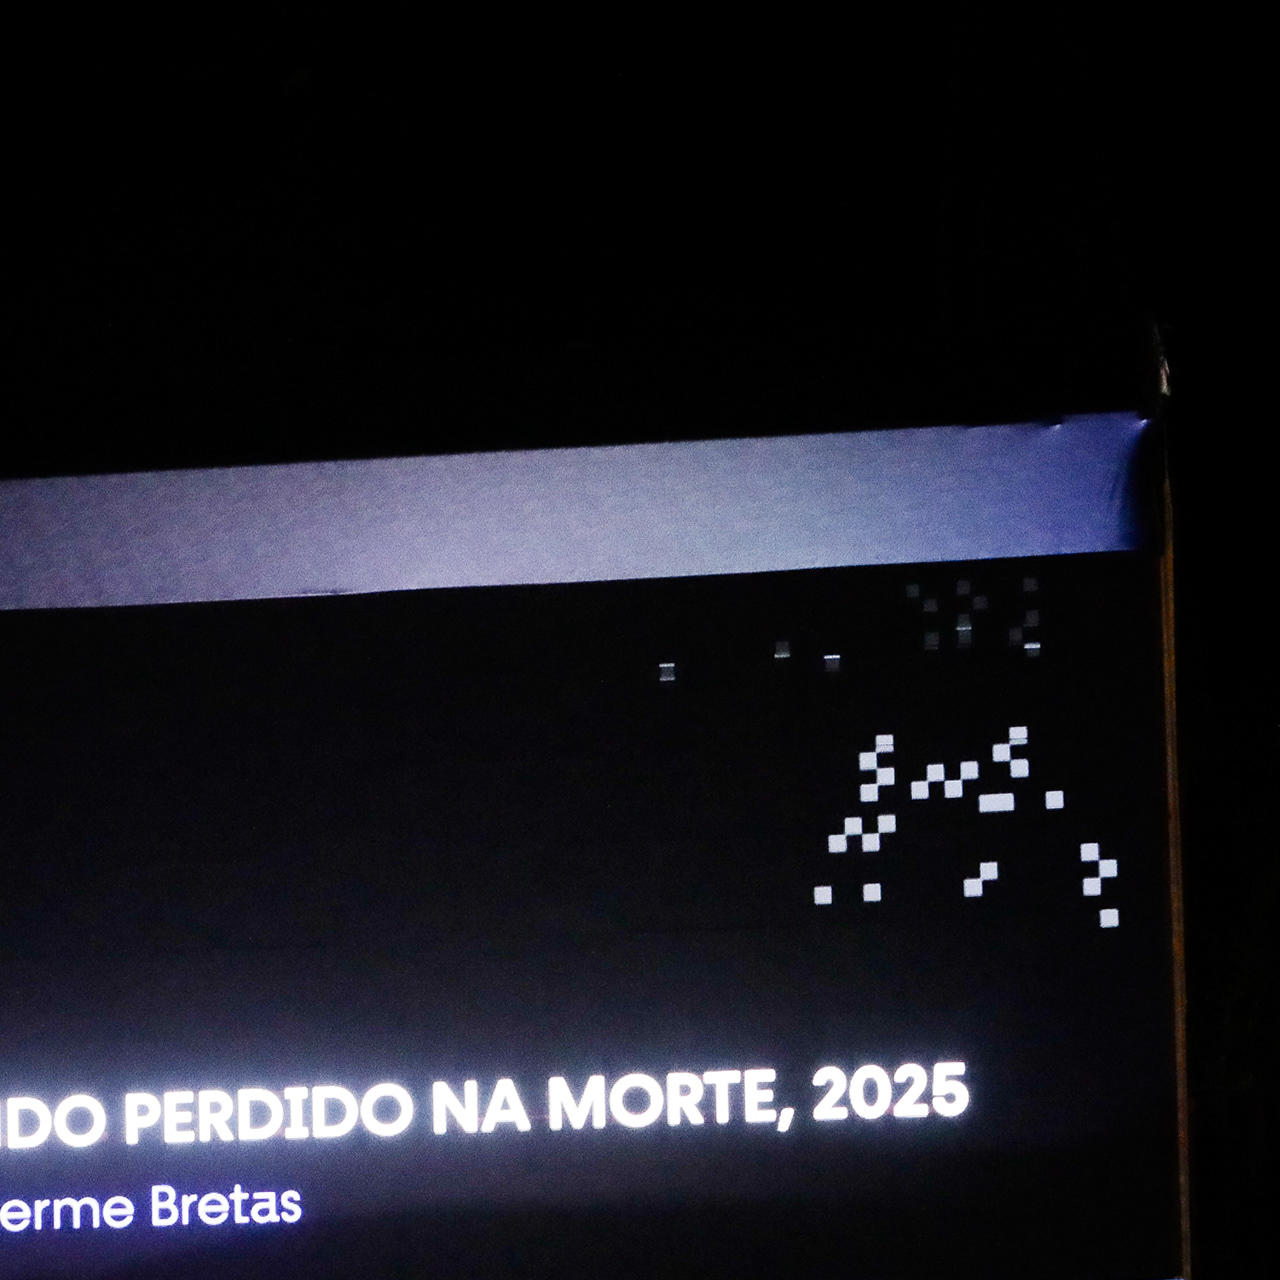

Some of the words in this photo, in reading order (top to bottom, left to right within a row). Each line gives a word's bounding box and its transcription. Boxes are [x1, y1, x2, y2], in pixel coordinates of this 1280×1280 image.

[124, 1081, 414, 1146] PERDIDO
[432, 1078, 531, 1136] NA
[548, 1068, 795, 1133] MORTE,
[811, 1061, 970, 1121] 2025
[151, 1184, 303, 1228] Bretas
